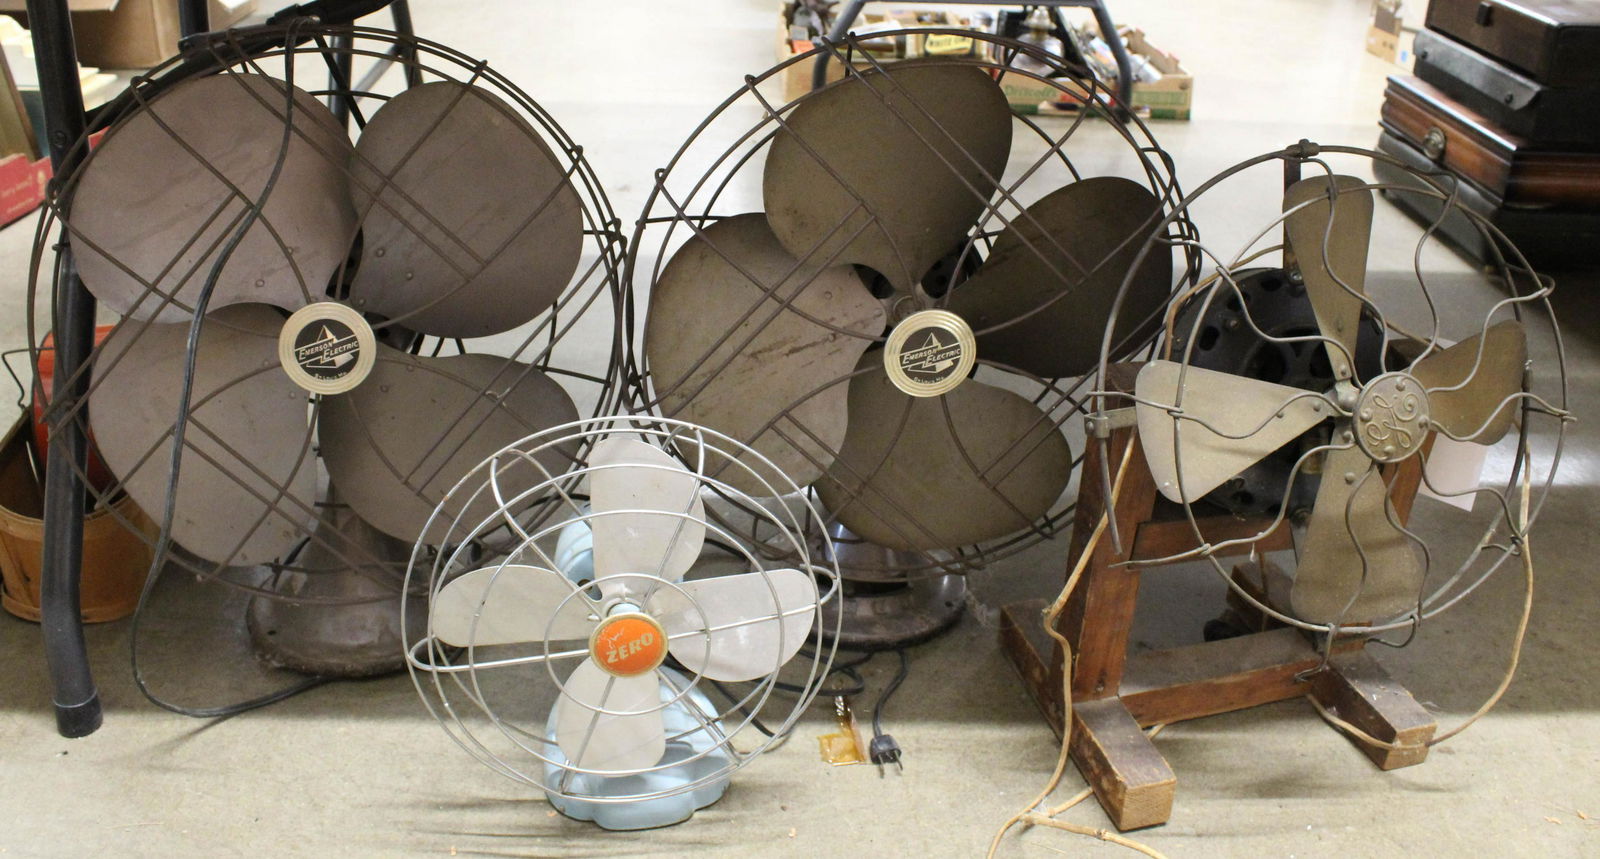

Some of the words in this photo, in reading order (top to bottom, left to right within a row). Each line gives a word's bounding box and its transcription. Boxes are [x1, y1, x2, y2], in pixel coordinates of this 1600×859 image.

[298, 341, 334, 361] EMERSON
[323, 340, 359, 361] ELECTRIC
[902, 348, 937, 365] EMERSON
[925, 348, 961, 366] ELECTRIC
[606, 632, 654, 664] ZERO
